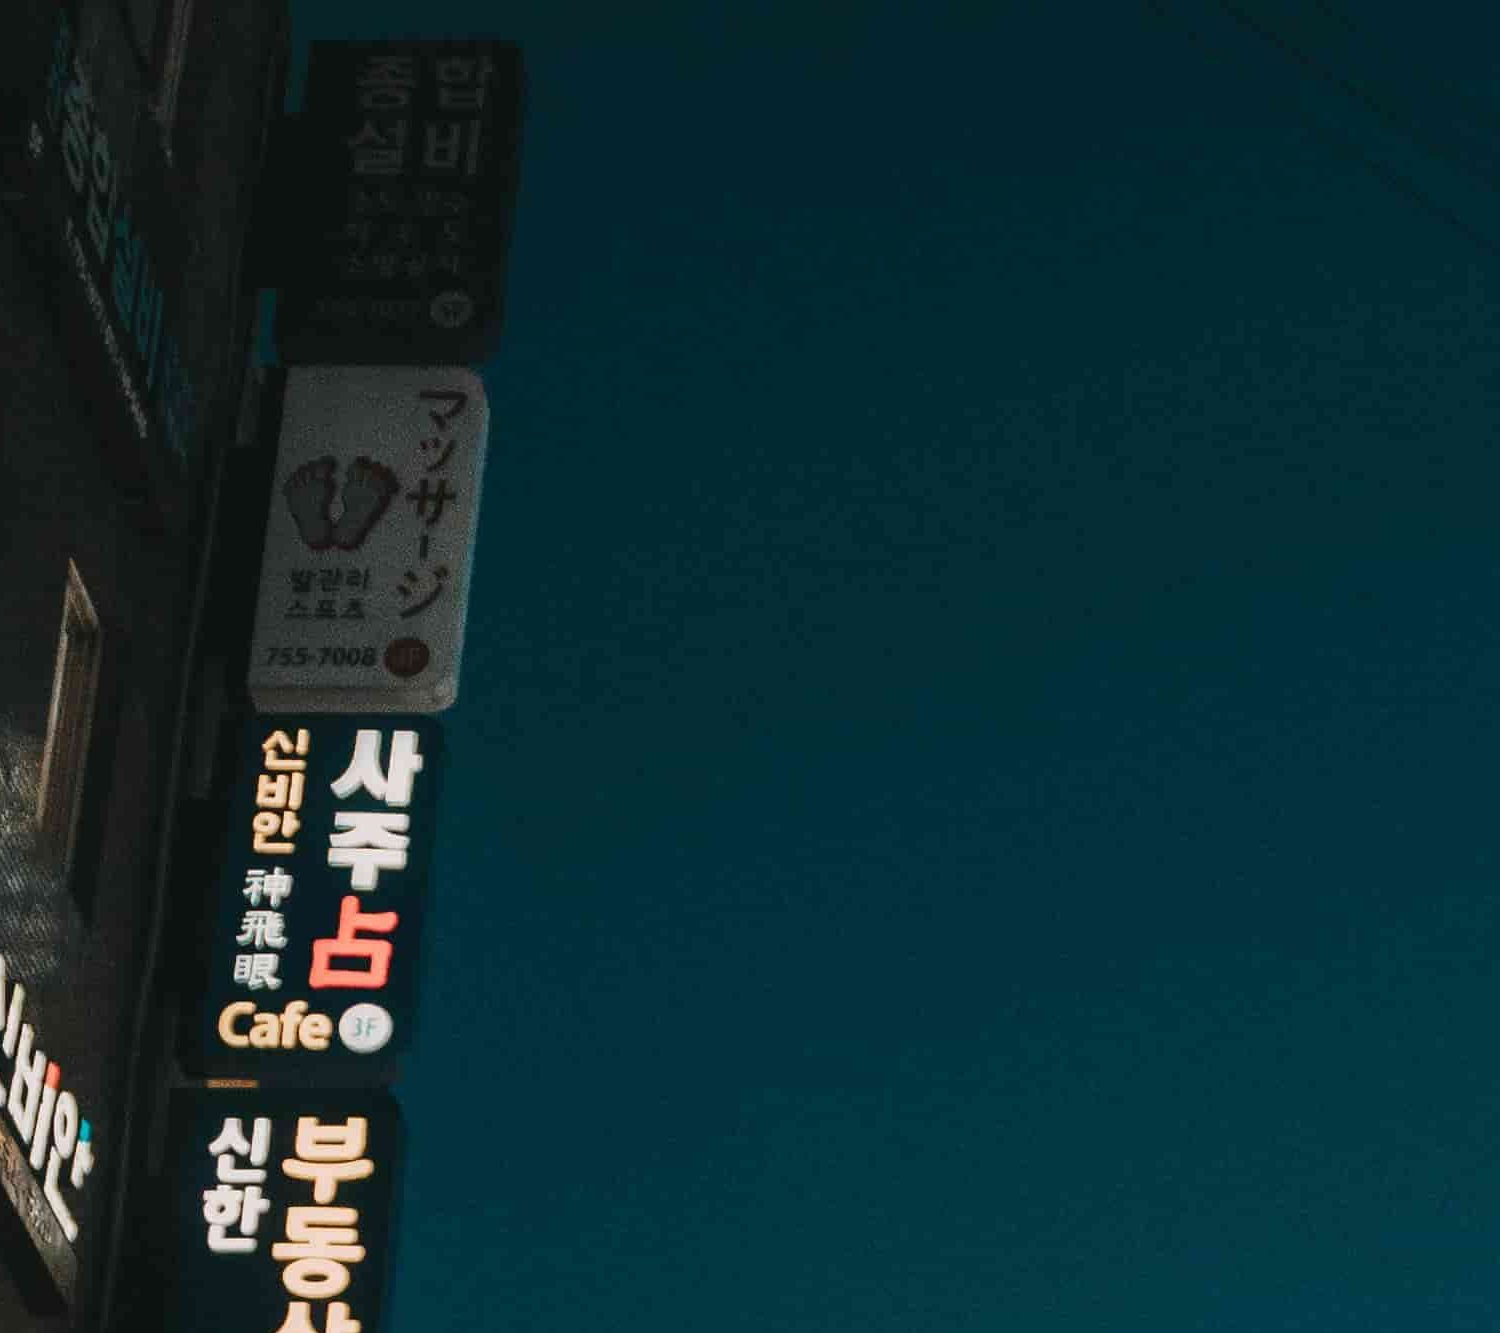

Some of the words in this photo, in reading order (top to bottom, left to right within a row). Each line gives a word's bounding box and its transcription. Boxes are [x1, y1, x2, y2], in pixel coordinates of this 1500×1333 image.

[396, 388, 468, 619] マッサージ
[266, 645, 376, 667] 755-7008
[252, 727, 310, 855] 신비안
[232, 866, 293, 991] 神飛眼
[217, 1000, 333, 1051] Cafe
[202, 1116, 272, 1254] 신한
